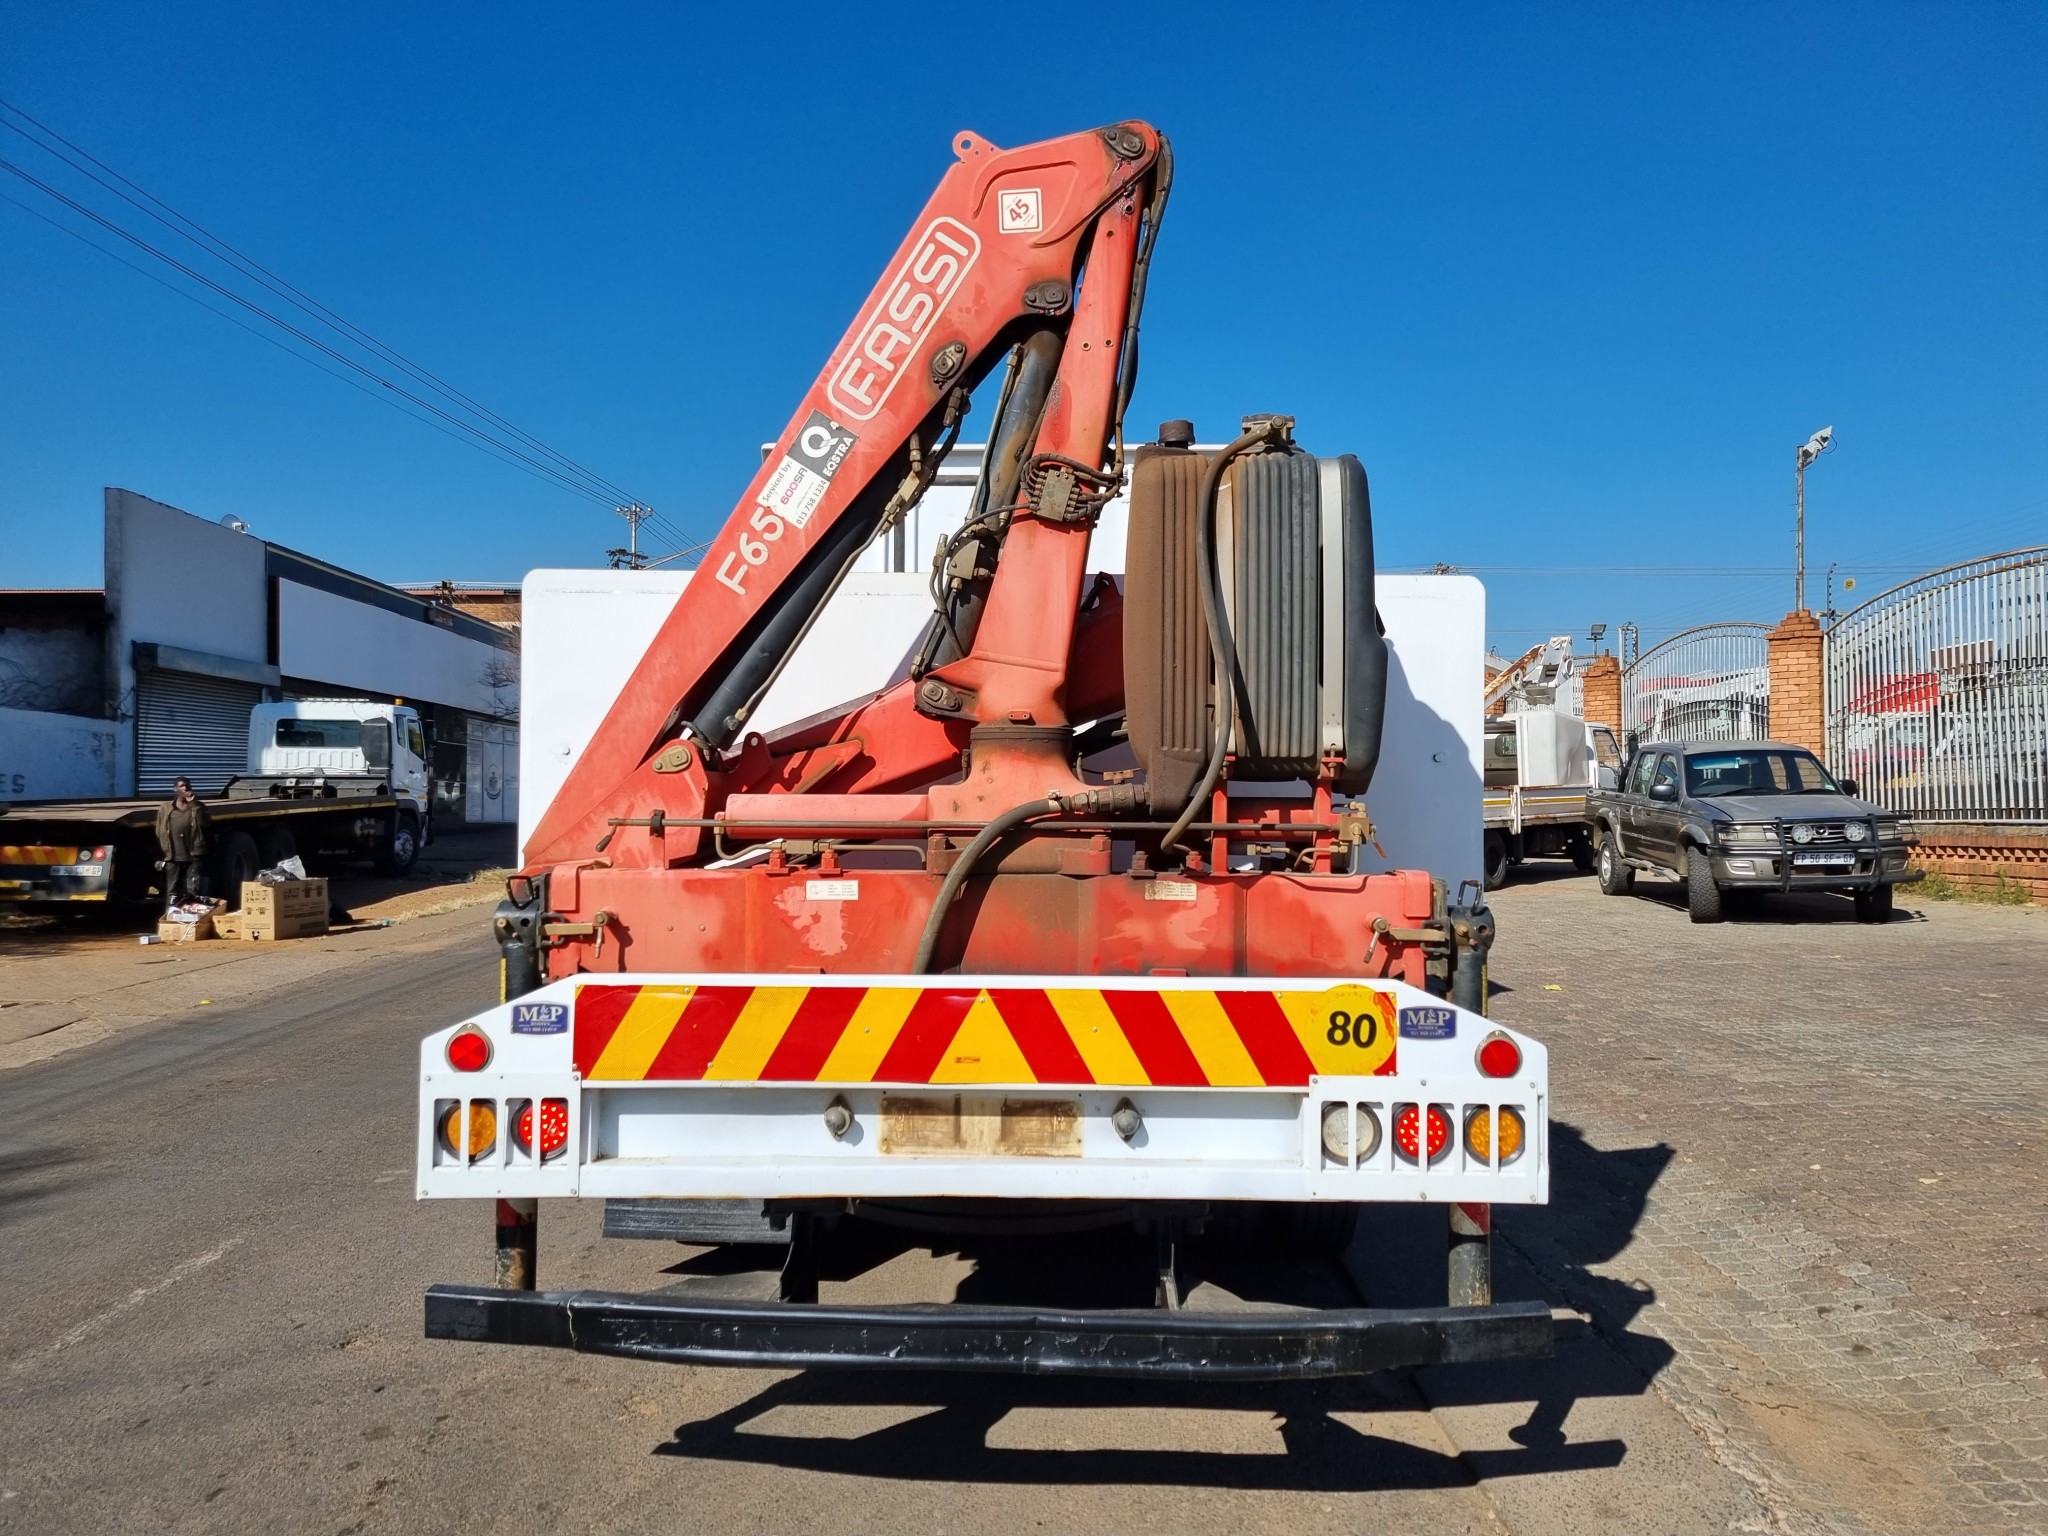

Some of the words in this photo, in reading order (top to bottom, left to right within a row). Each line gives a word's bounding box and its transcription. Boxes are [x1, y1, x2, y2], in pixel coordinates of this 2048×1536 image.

[1009, 198, 1030, 222] 45
[839, 230, 970, 407] FASSI
[822, 437, 854, 478] EQSTRA
[762, 471, 785, 502] Serviced
[780, 467, 808, 505] 600SA
[796, 511, 808, 525] 013
[805, 497, 816, 511] 758
[813, 480, 827, 497] 1334
[715, 506, 784, 596] F65
[1326, 1010, 1378, 1049] 80
